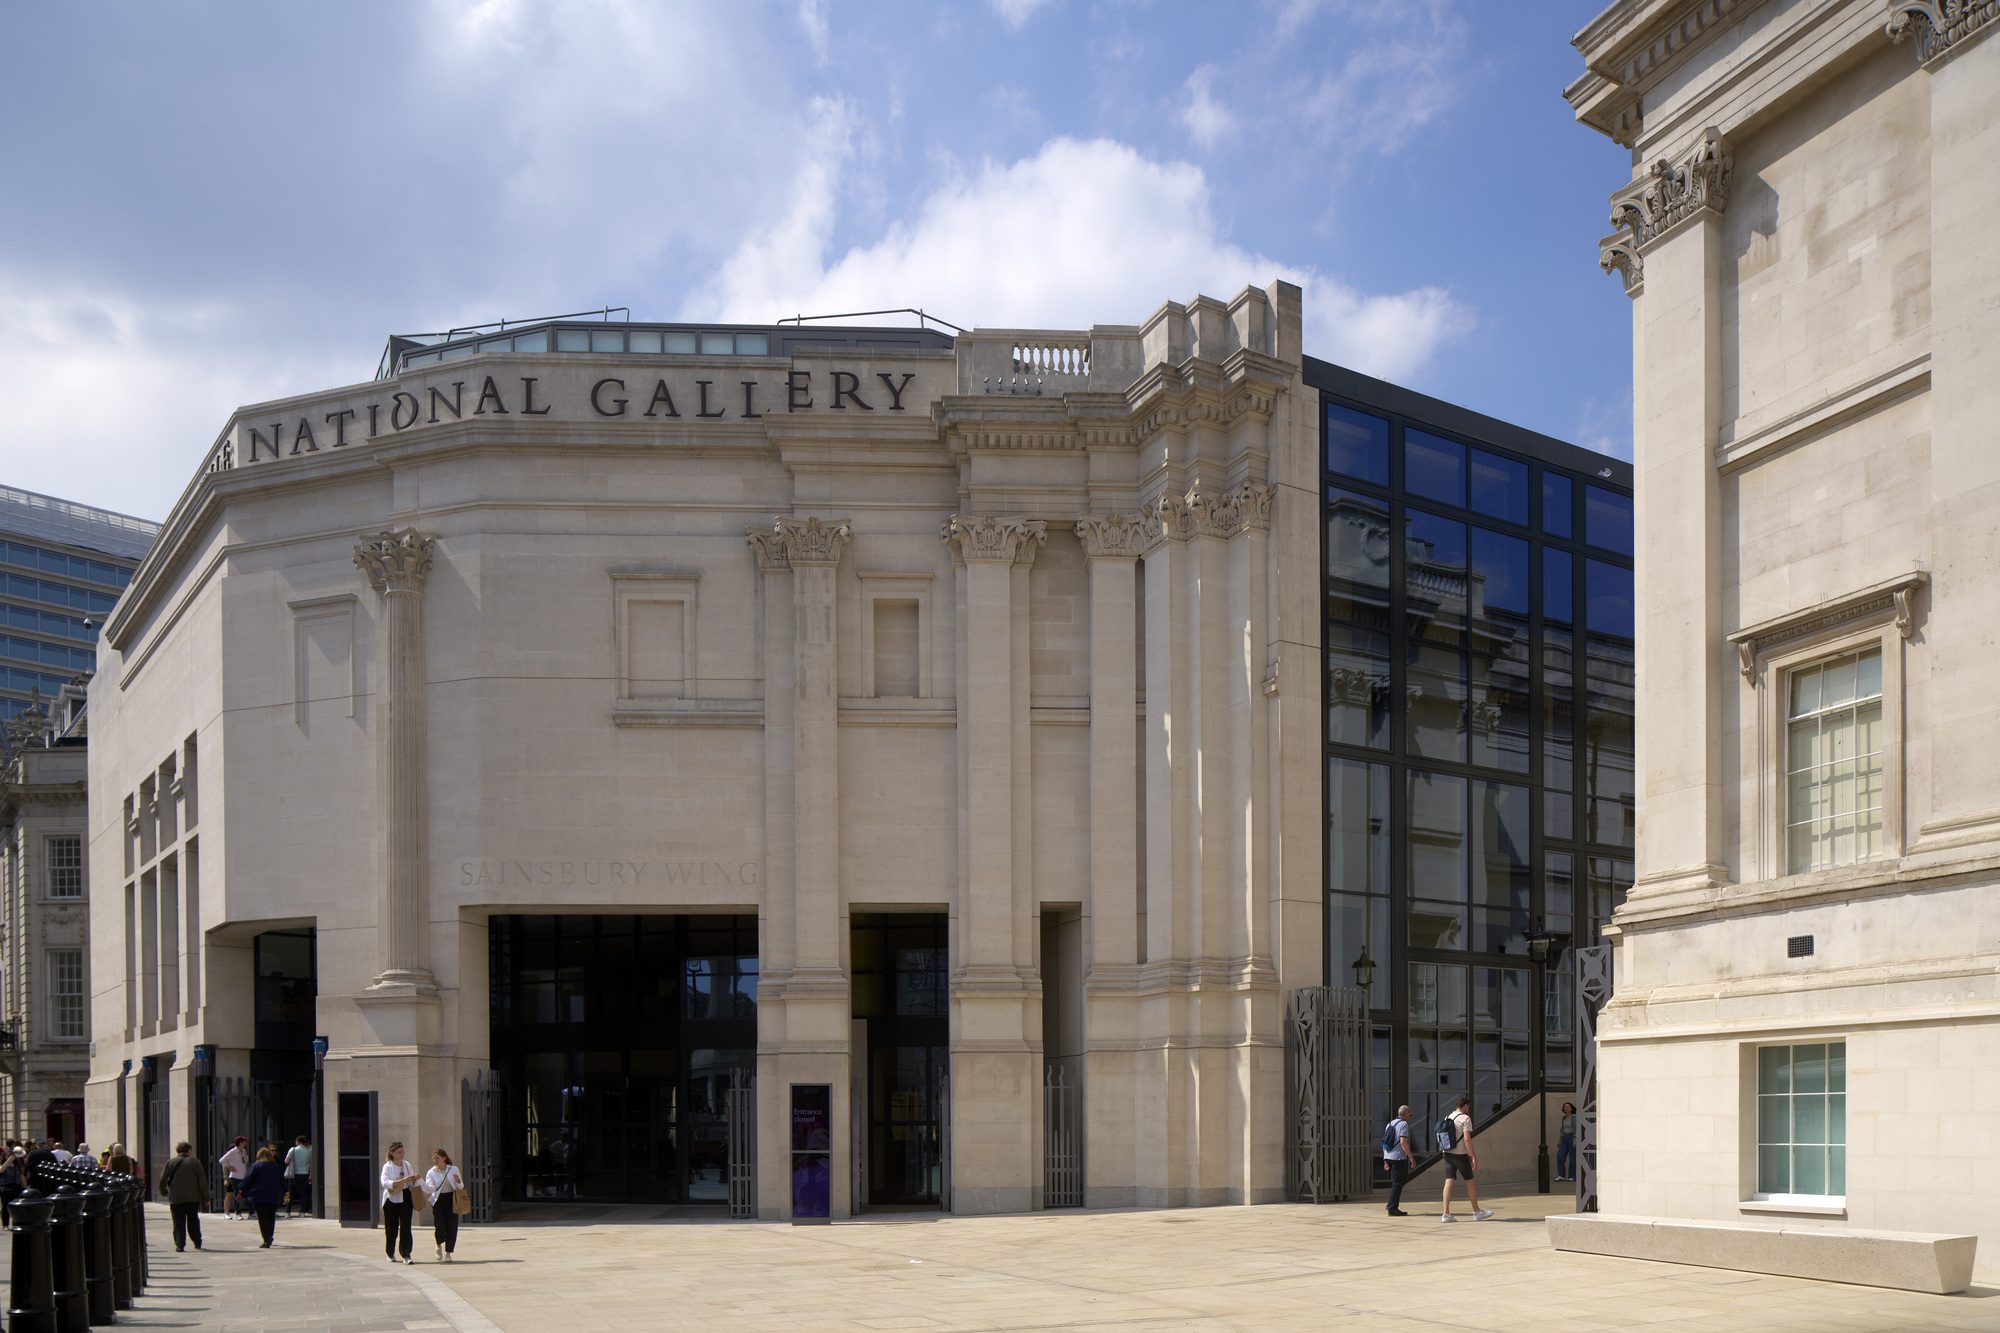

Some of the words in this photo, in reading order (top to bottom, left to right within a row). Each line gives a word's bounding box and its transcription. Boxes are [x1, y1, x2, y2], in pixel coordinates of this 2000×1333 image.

[247, 375, 551, 463] NATIONAL
[590, 371, 915, 418] GALLERY
[459, 861, 649, 886] SAINSBURY
[663, 861, 759, 886] WING
